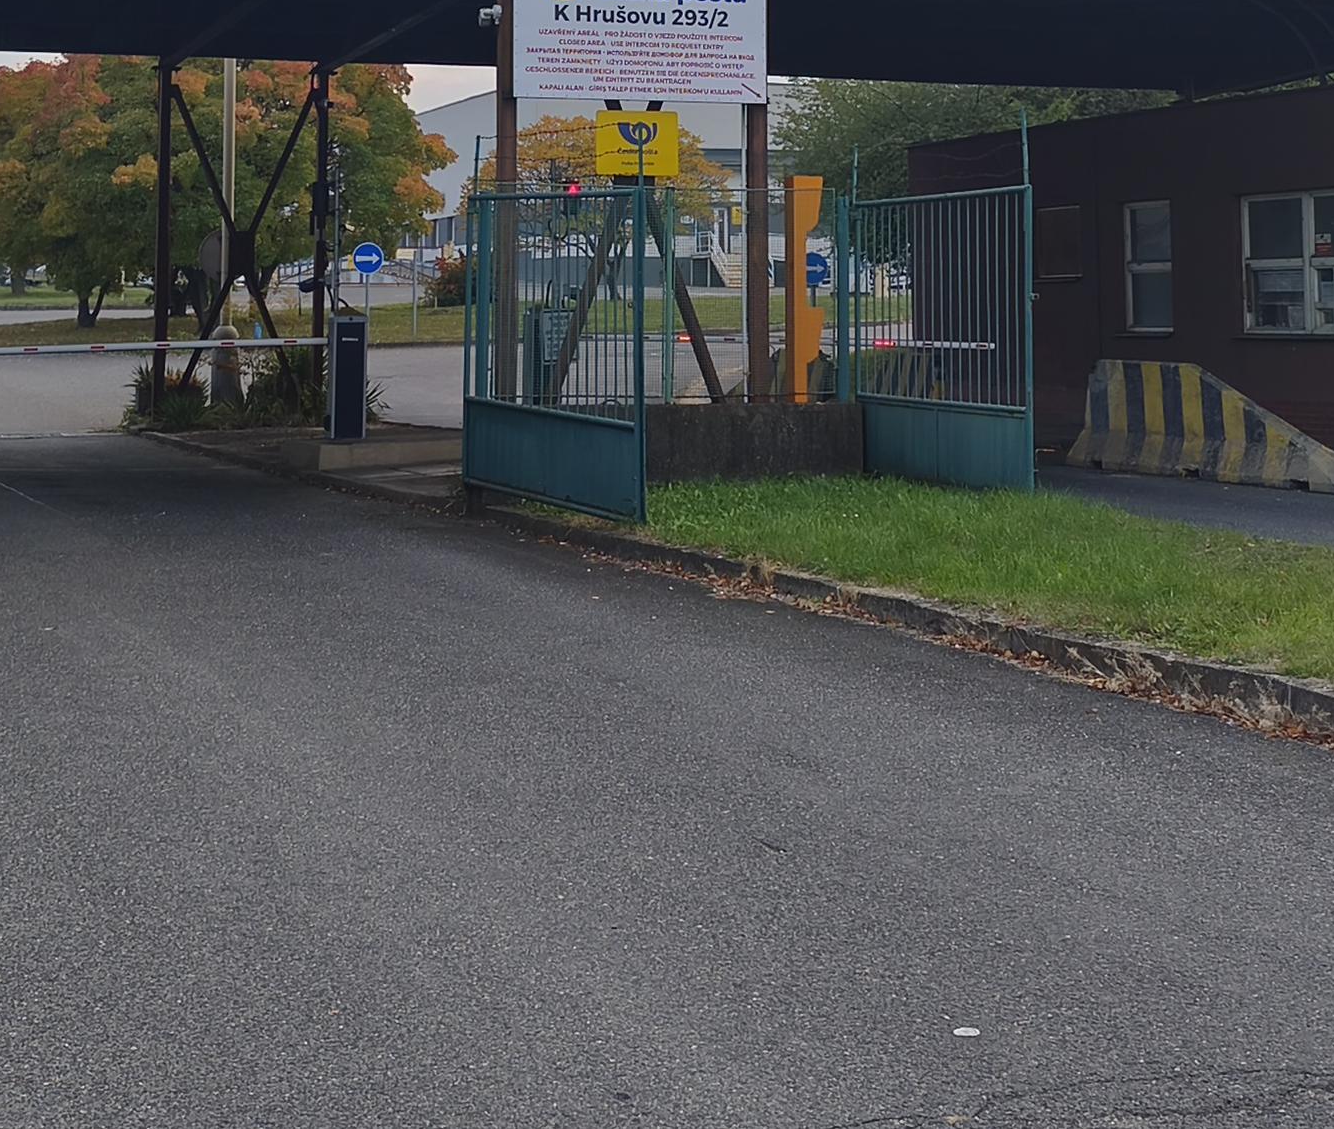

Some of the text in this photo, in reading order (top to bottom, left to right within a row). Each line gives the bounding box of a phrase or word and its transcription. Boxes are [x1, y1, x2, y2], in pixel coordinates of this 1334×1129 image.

[554, 4, 729, 29] K Hrušovu 293/2
[620, 30, 646, 38] ŽÁDOST
